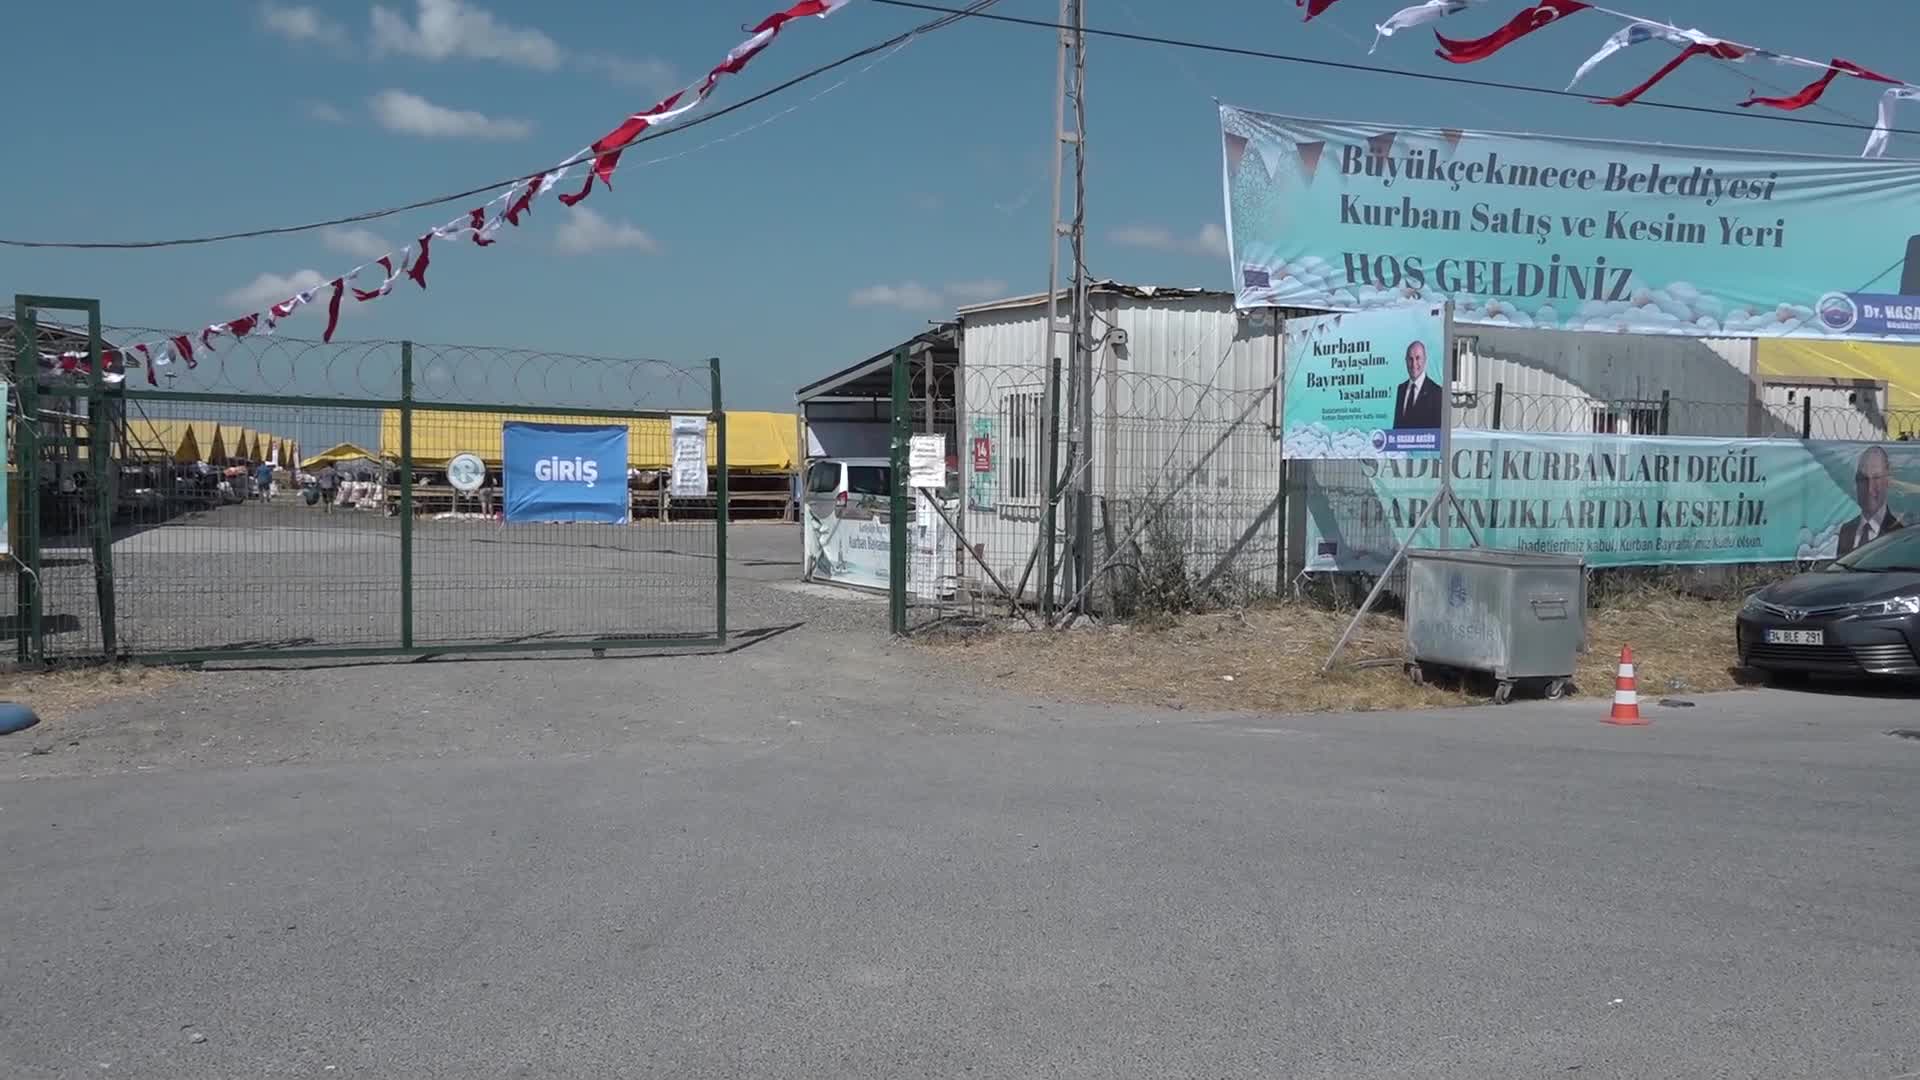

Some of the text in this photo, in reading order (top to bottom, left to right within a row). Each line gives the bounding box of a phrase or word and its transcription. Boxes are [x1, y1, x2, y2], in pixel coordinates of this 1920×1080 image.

[1342, 144, 1778, 206] Büyükçekmece Belediyesi
[1340, 194, 1785, 248] Kurban Satış ve Kesim Yeri
[1343, 252, 1633, 302] HOŞ GELDİNİZ
[1863, 304, 1884, 318] Dr.
[1313, 338, 1370, 357] Kurbanı
[1307, 373, 1364, 392] Bayramı
[1338, 386, 1392, 404] Yaşatalım!
[534, 456, 599, 488] GİRİŞ
[1502, 450, 1680, 484] KURBANLARI
[1620, 537, 1653, 552] Kurban
[1770, 631, 1820, 643] 34 BLE 291
